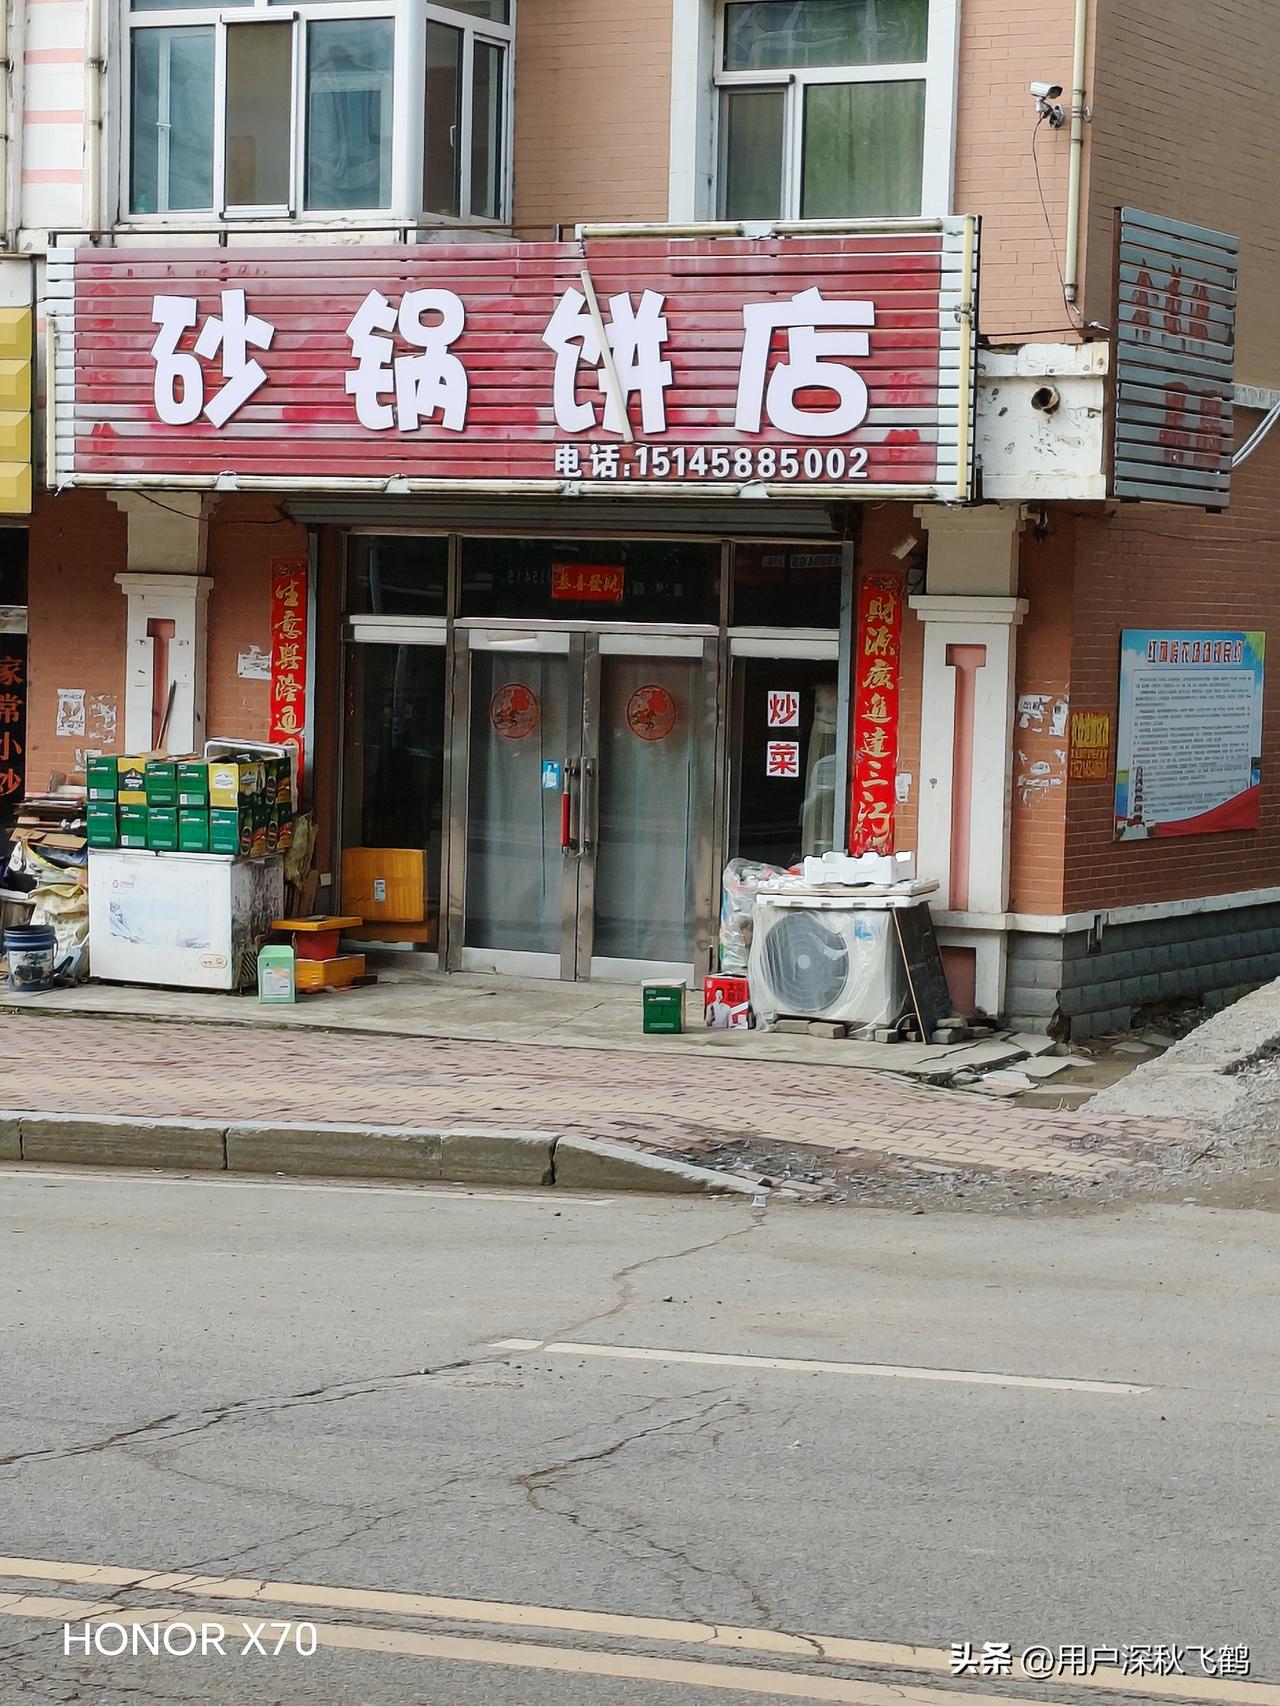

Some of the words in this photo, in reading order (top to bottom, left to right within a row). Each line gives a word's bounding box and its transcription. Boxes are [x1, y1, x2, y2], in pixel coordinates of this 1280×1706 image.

[150, 286, 876, 438] 砂锅饼店
[768, 693, 798, 775] 炒菜
